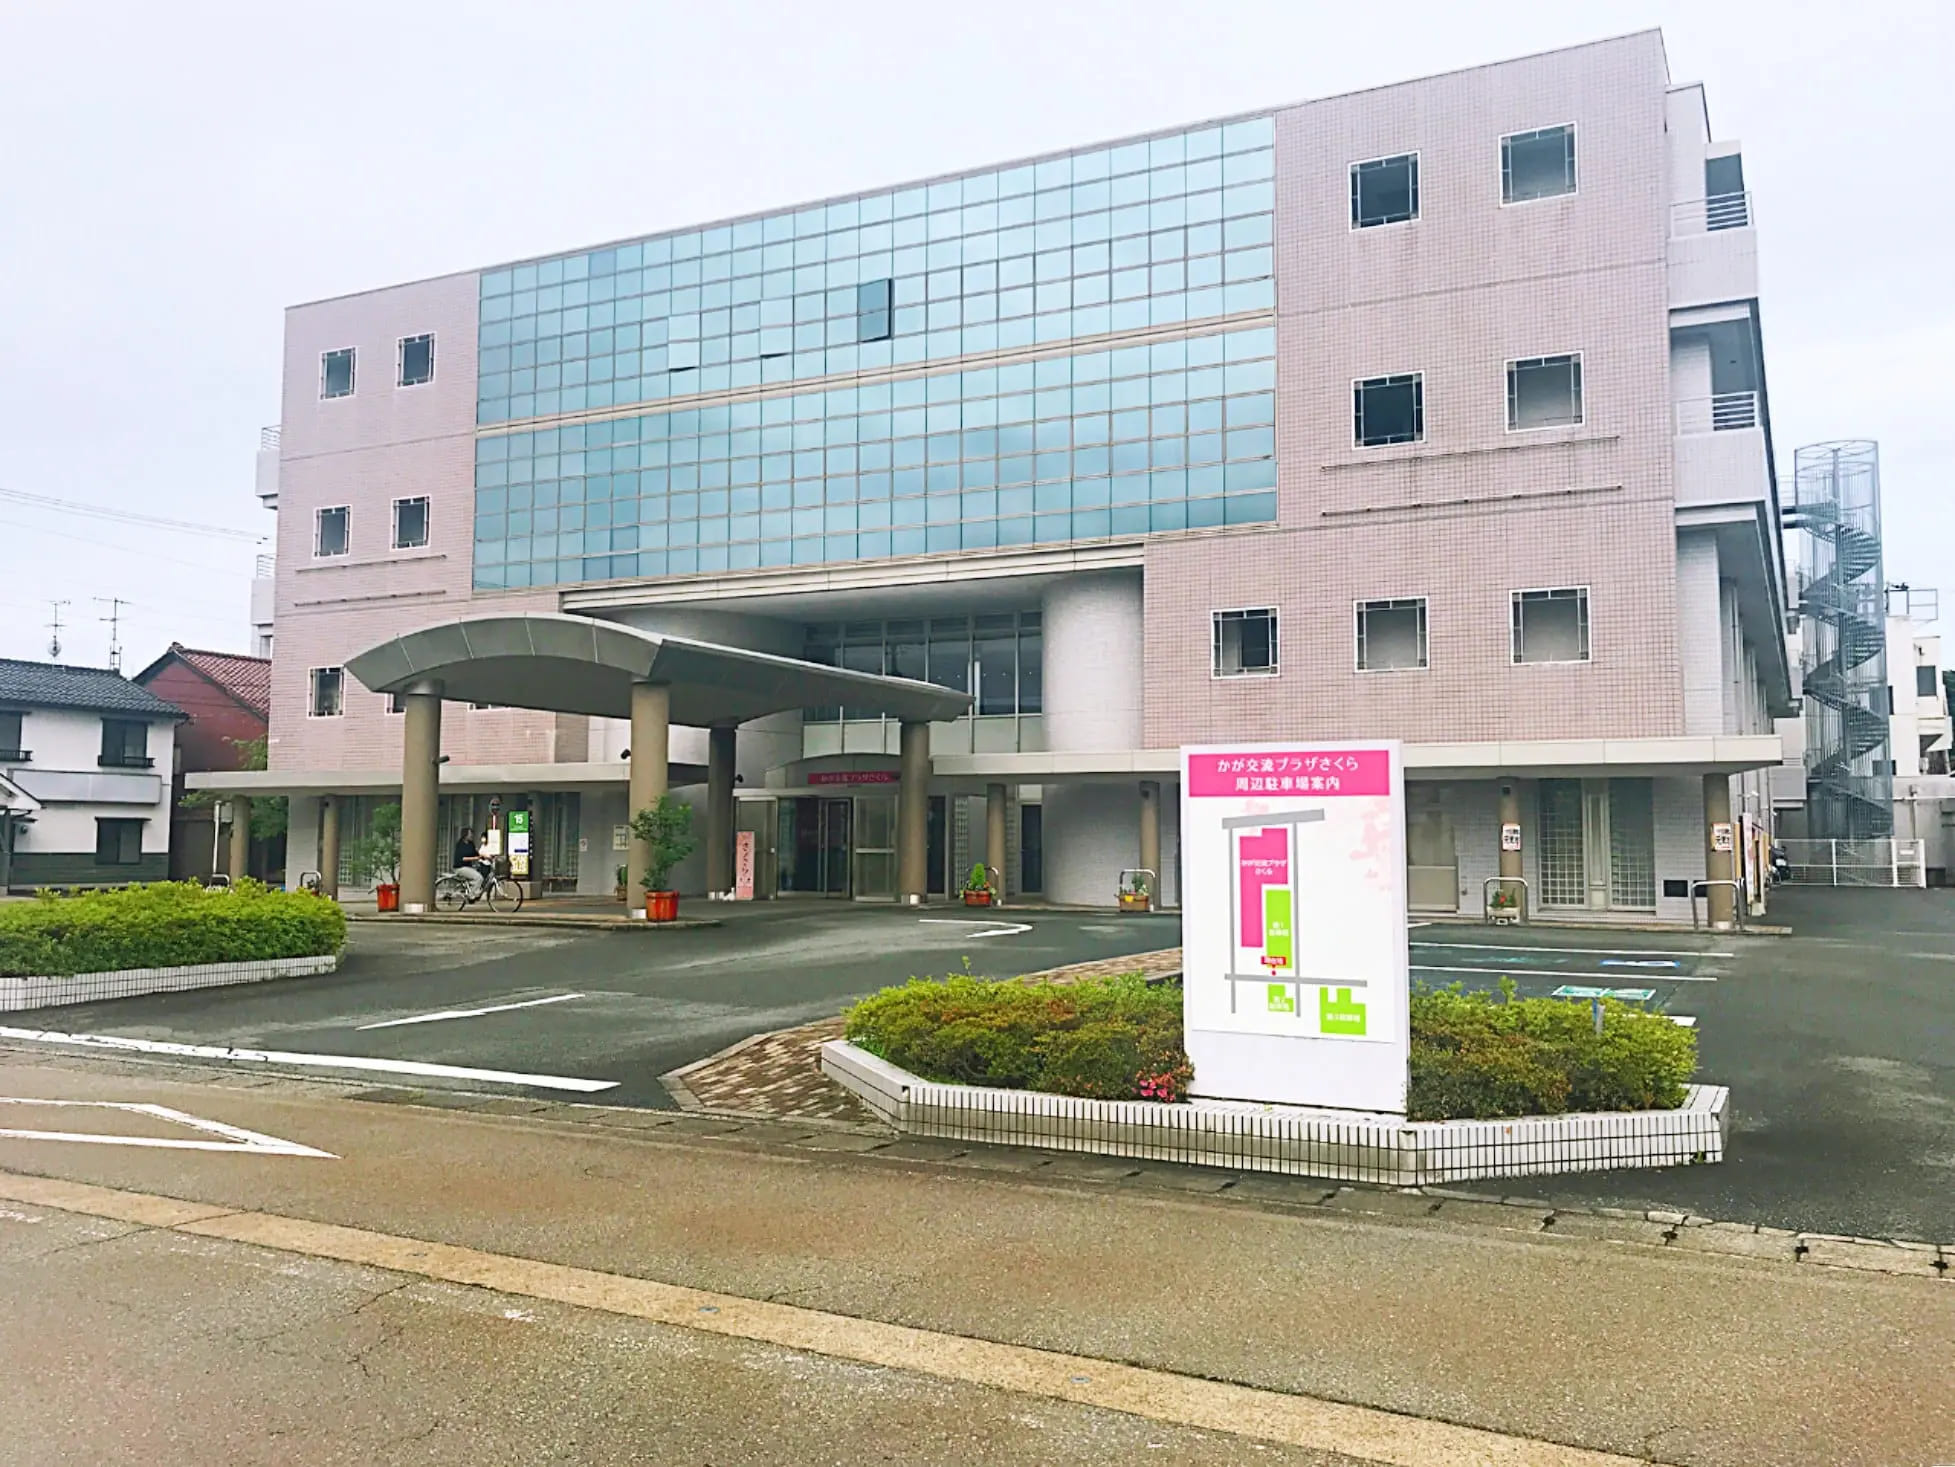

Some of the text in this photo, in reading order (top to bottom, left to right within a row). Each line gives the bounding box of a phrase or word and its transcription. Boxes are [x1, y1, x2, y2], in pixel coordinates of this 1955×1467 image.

[1217, 756, 1359, 773] かが交流プラザさくら
[1235, 775, 1341, 792] 周辺駐車場案内
